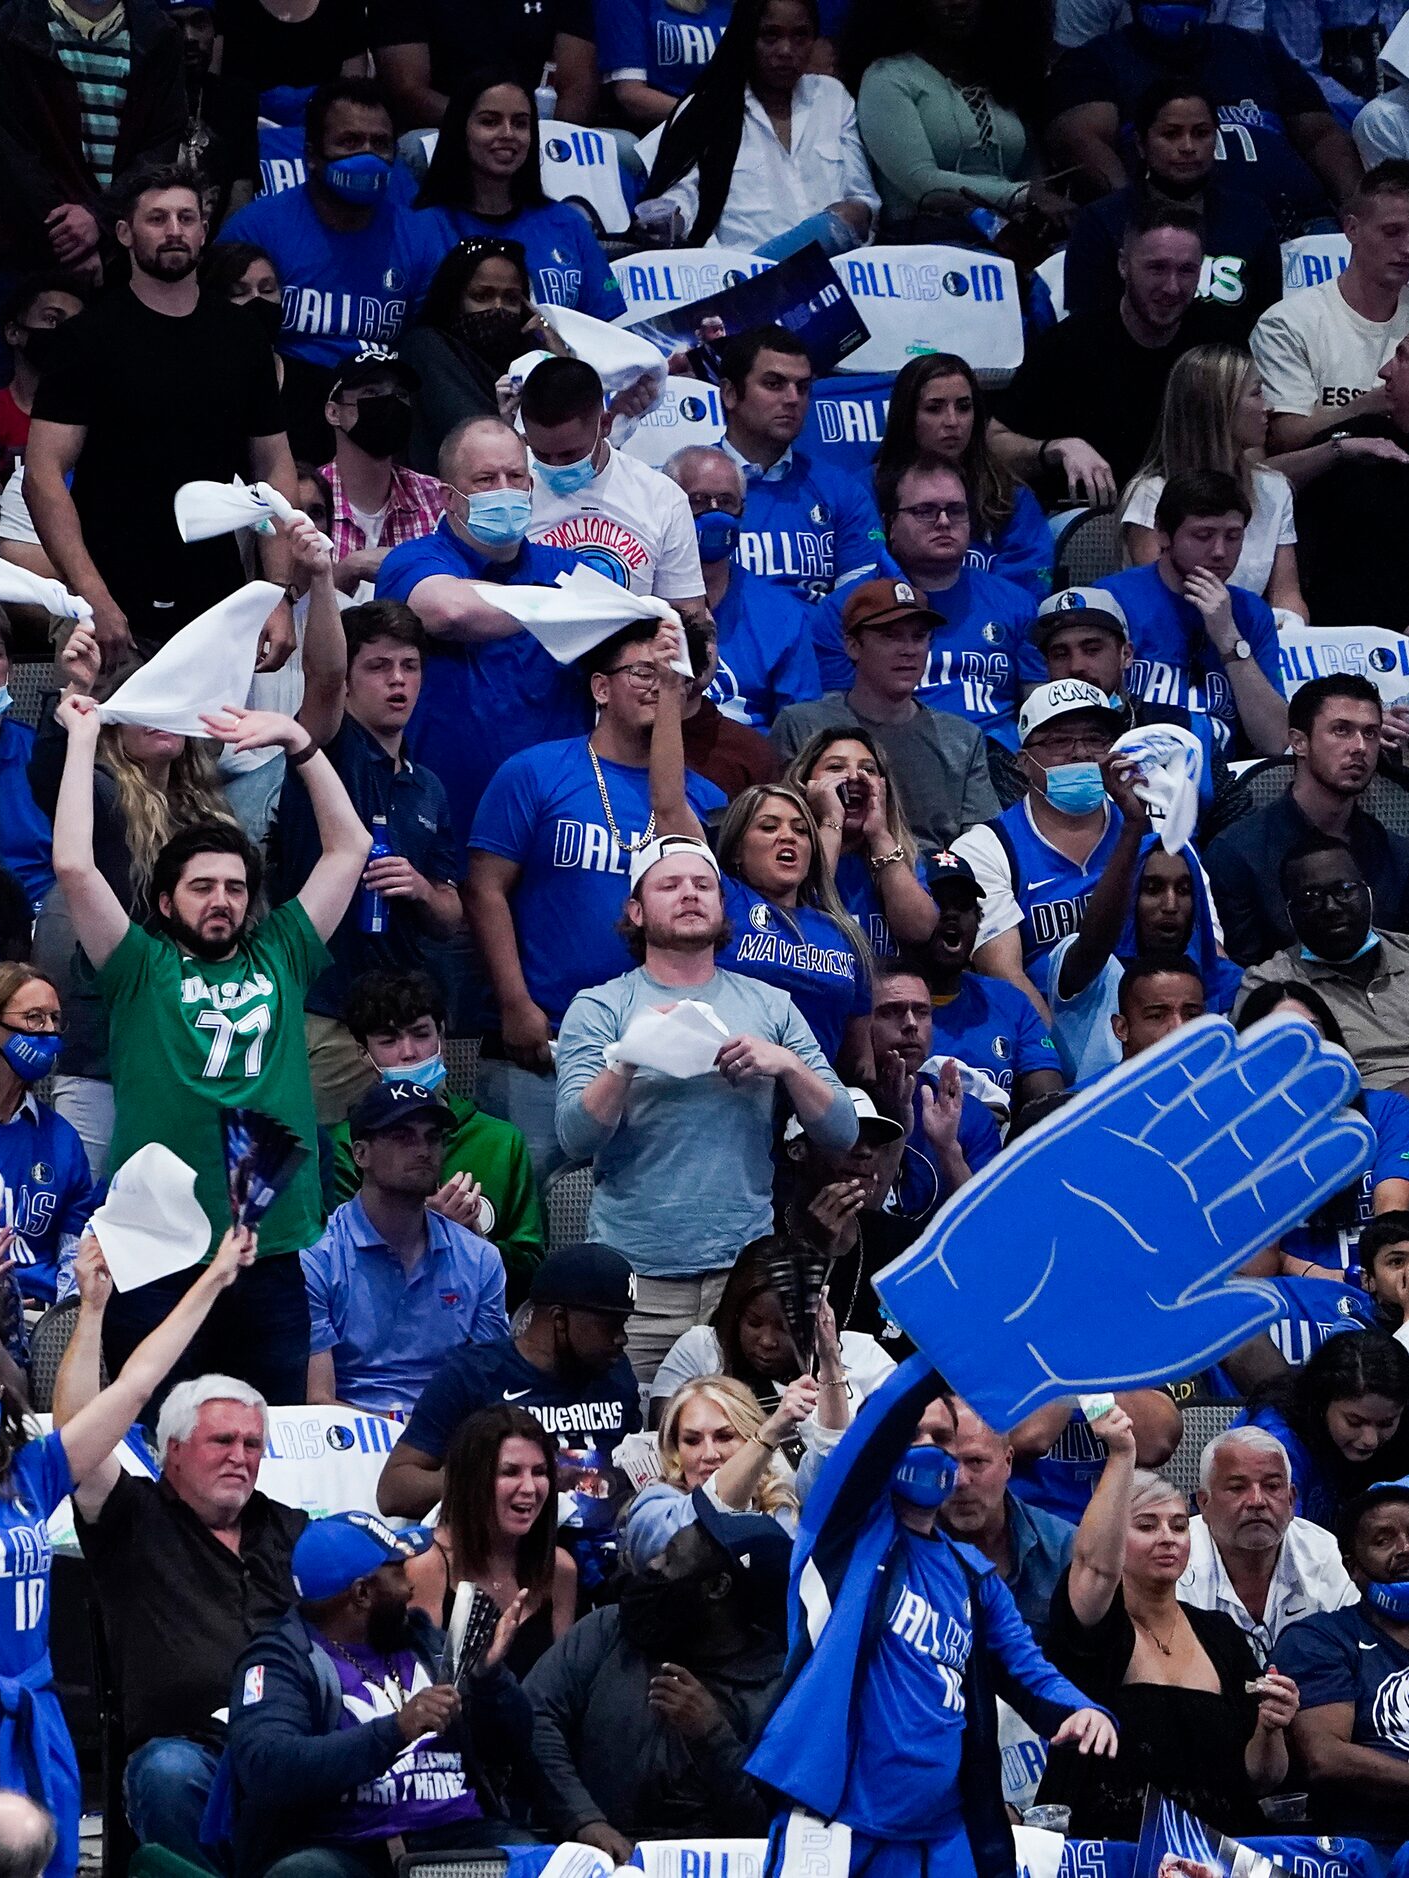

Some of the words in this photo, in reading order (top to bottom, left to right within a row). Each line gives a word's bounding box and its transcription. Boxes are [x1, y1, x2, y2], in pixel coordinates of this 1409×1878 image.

[281, 286, 406, 339] DALLAS
[180, 972, 274, 1011] DALLAS
[194, 1003, 271, 1078] 77
